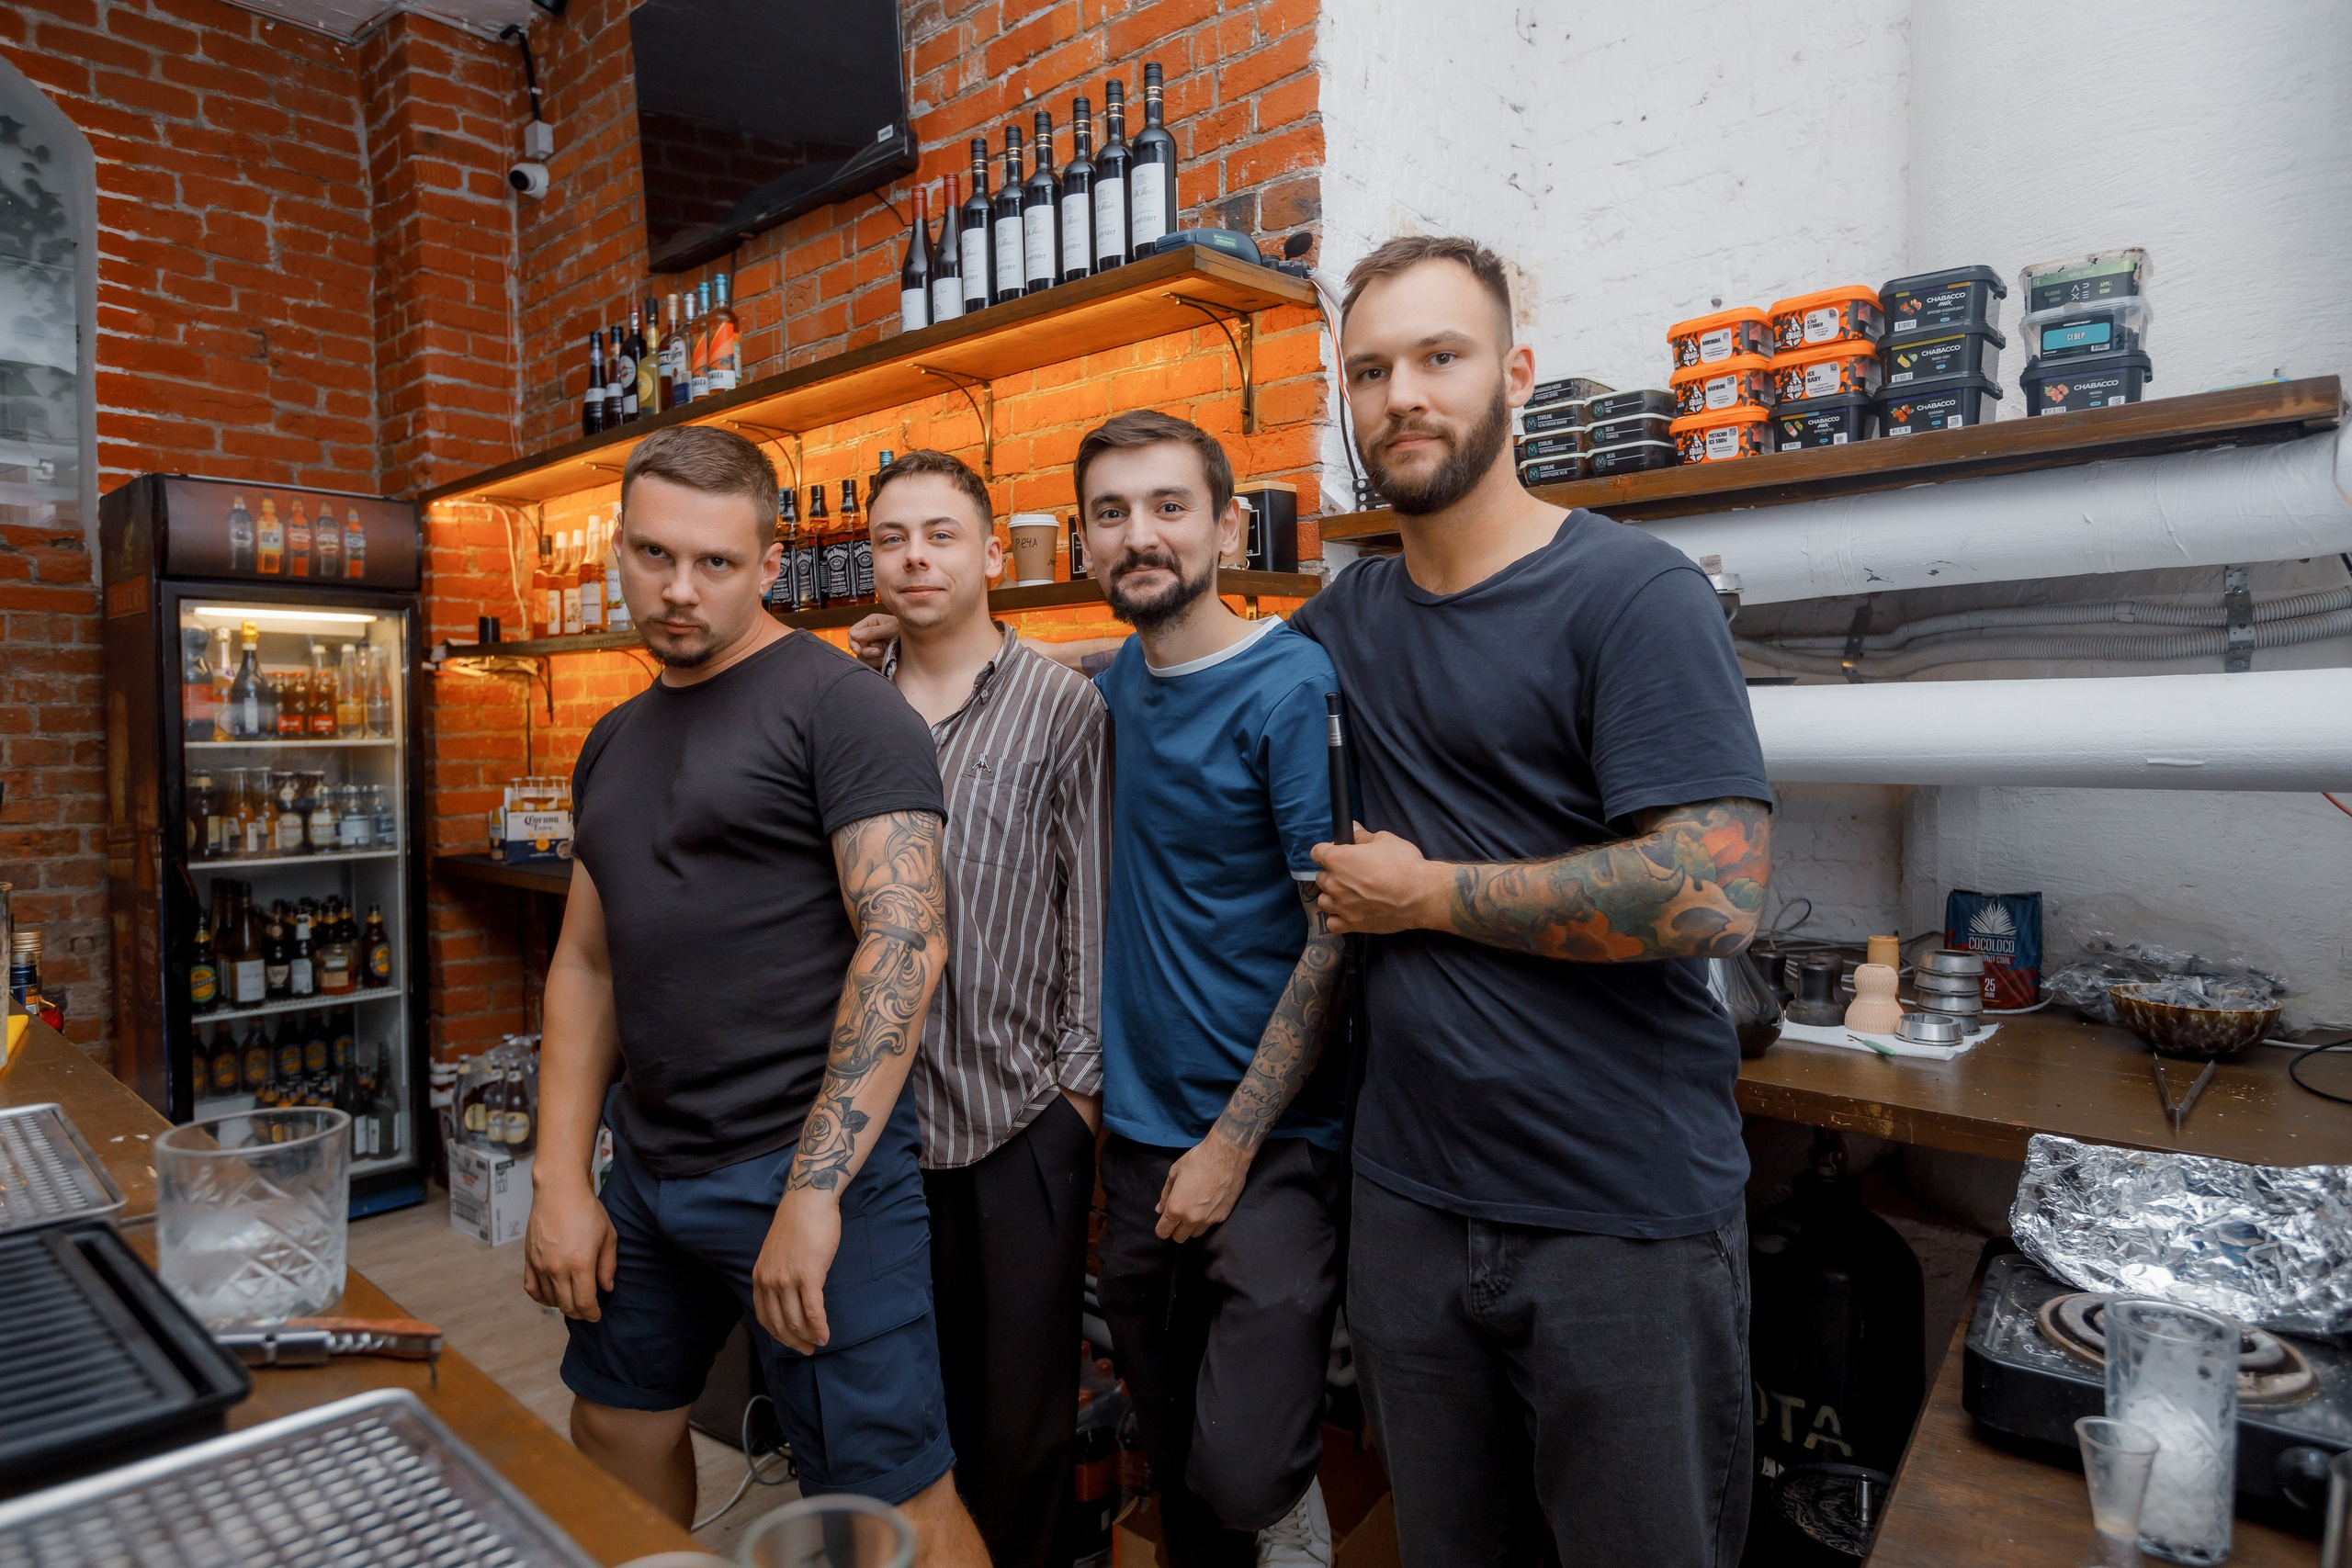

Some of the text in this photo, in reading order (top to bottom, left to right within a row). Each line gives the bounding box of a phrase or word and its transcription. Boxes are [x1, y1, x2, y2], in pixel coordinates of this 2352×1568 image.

[1926, 292, 1966, 303] CHABACCO
[2066, 332, 2086, 342] СЕВЕР
[1921, 344, 1961, 356] CHABACCO
[2074, 379, 2119, 391] CHABACCO
[1917, 400, 1955, 411] CHABACCO
[1808, 416, 1839, 425] CHABACCO
[525, 814, 560, 827] Corona
[1968, 937, 2015, 953] COCOLOCO
[1996, 955, 2010, 964] COAL
[1984, 978, 1996, 992] 25
